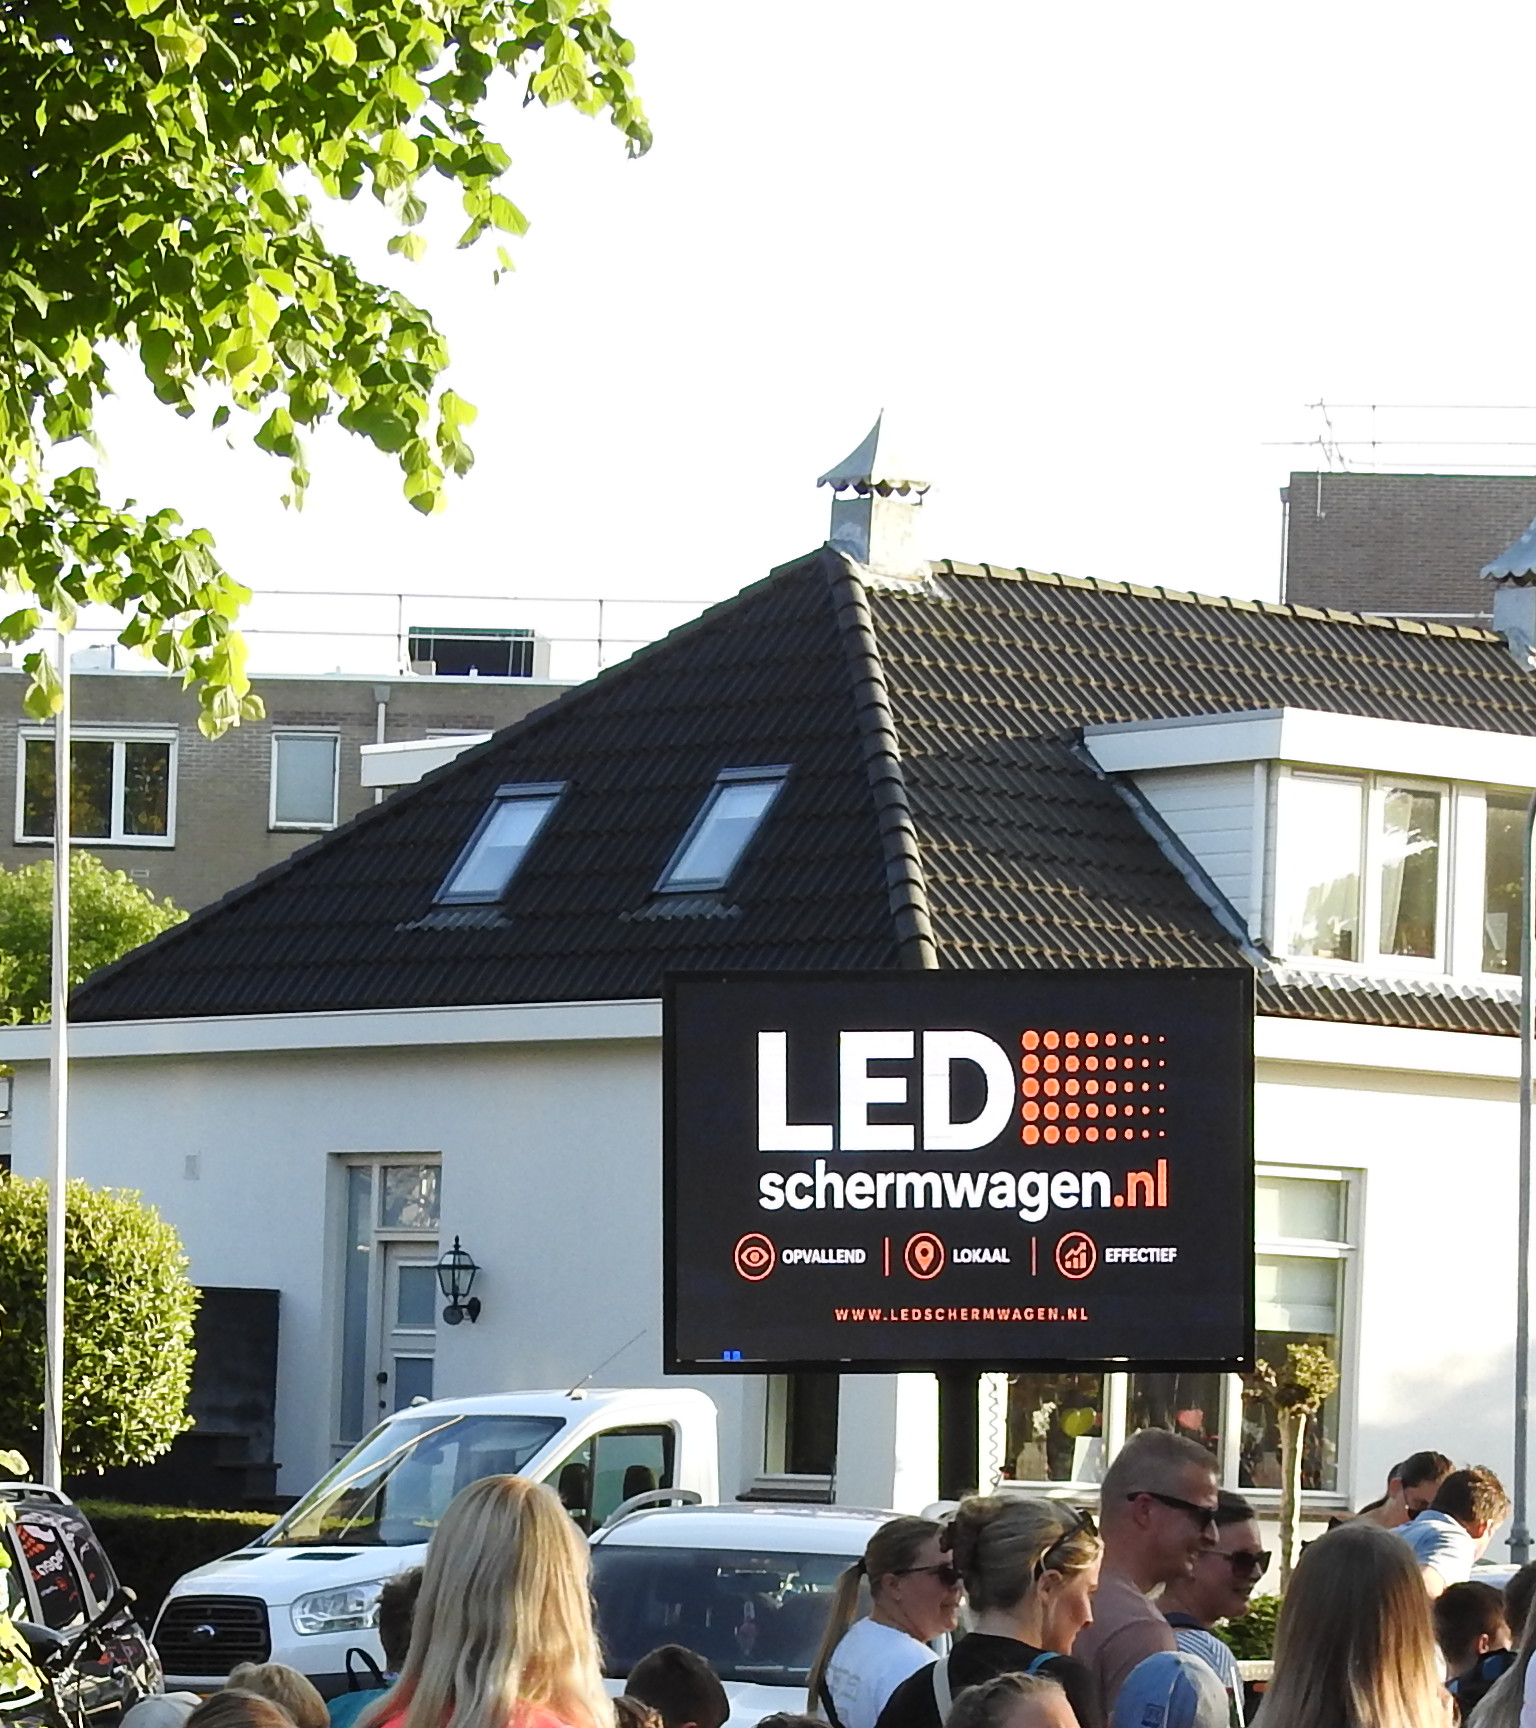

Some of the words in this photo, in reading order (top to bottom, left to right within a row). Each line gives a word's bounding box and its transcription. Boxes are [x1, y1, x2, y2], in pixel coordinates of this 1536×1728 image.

[758, 1031, 1015, 1151] LED
[759, 1159, 1167, 1222] schermwagen.nl
[782, 1249, 866, 1264] OPVALLEND
[953, 1248, 1010, 1263] LOKAAL
[1105, 1248, 1177, 1263] EFFECTIEF
[835, 1308, 1088, 1321] WWW.LEDSCHERMWAGEN.NL
